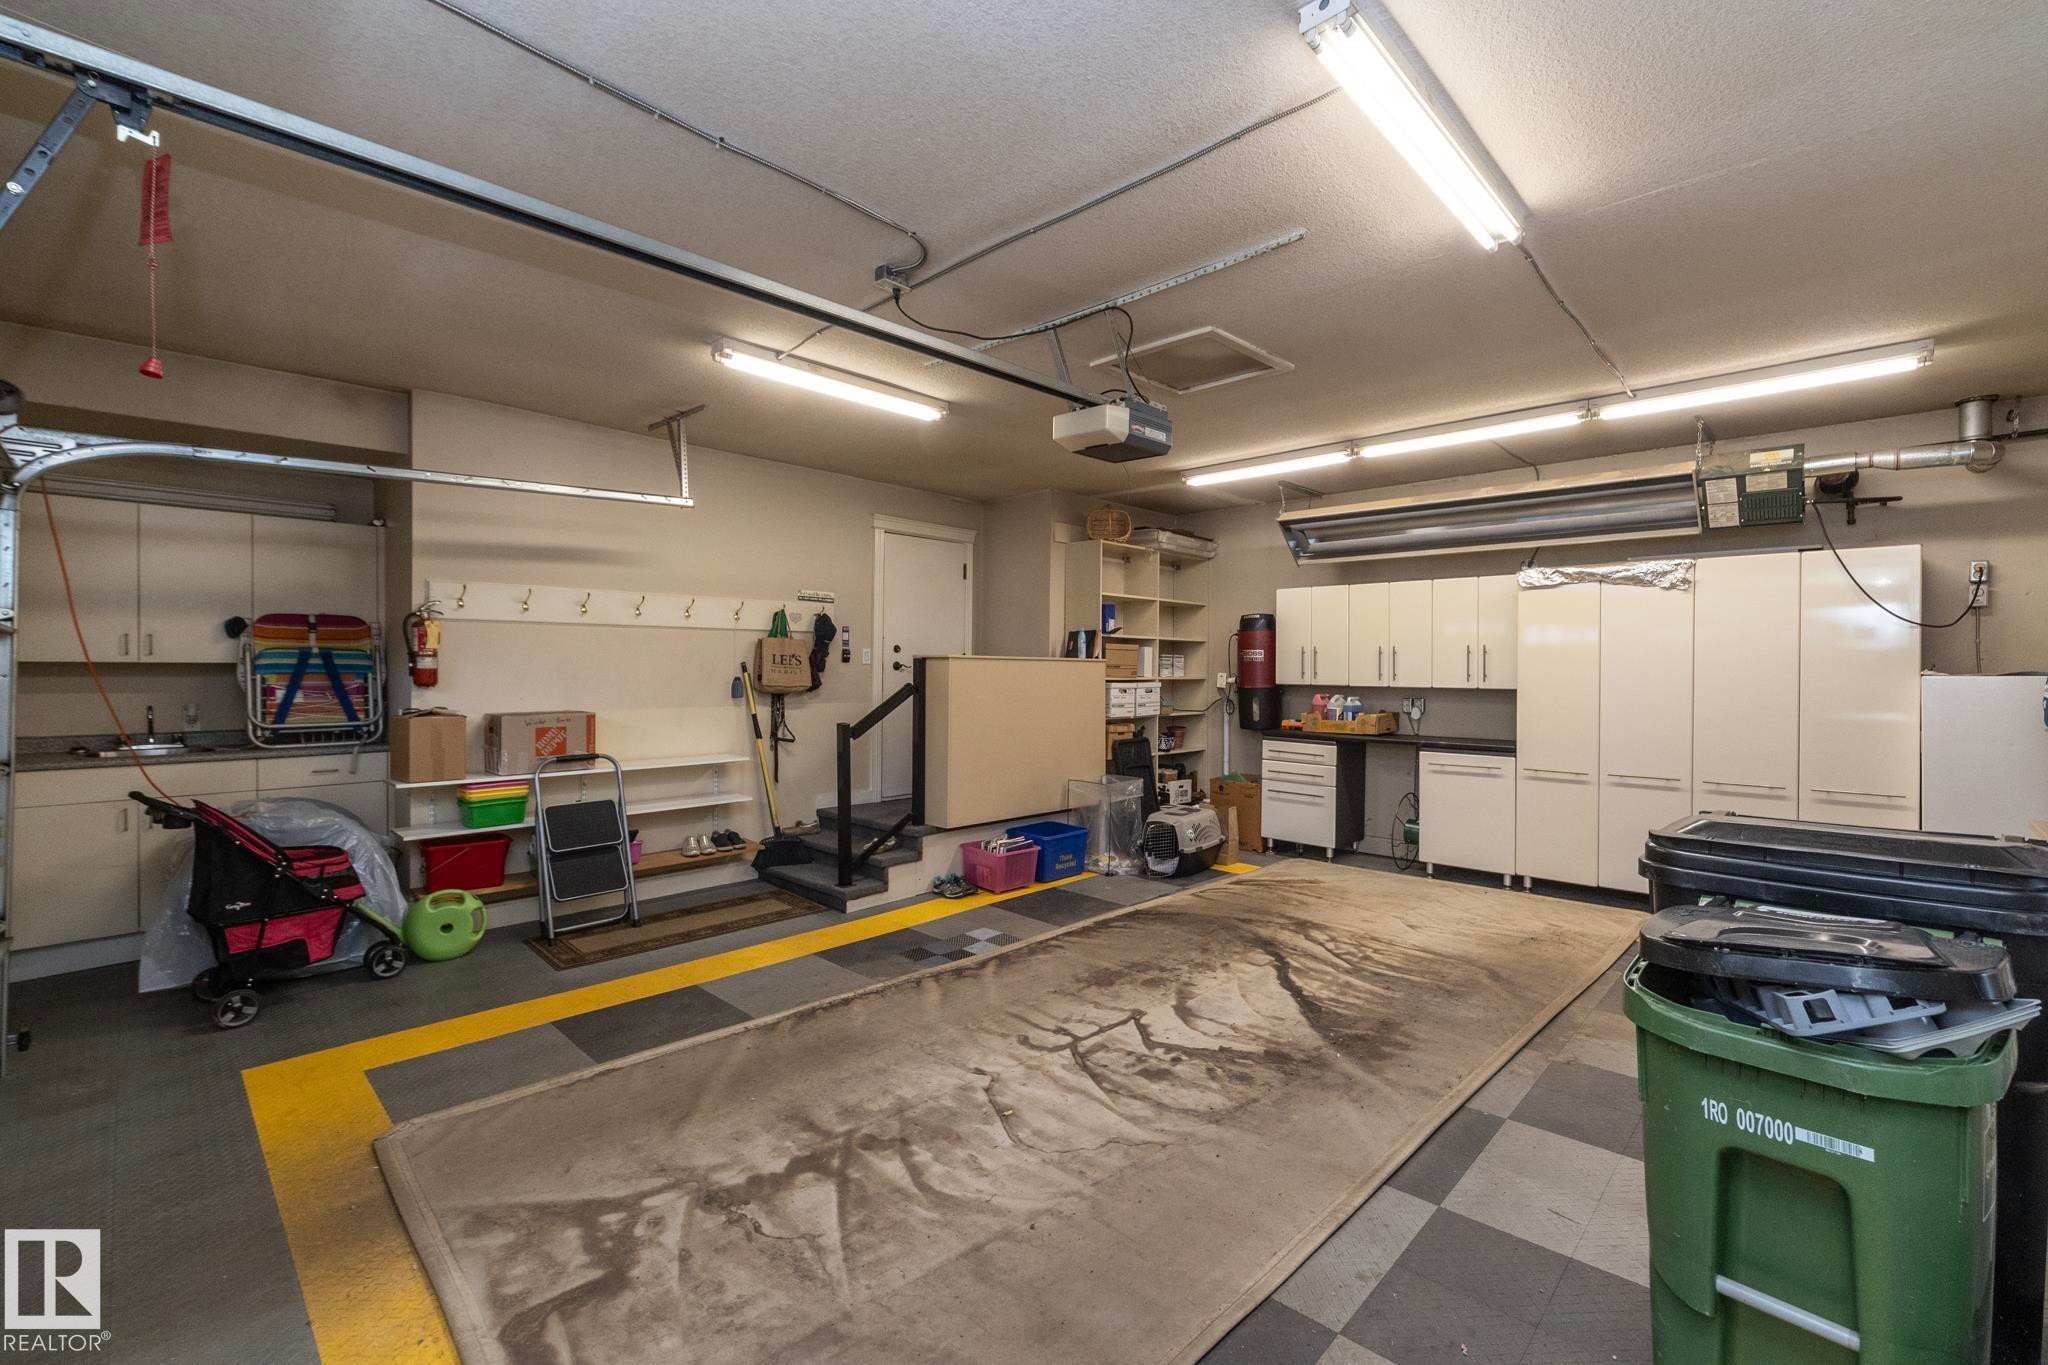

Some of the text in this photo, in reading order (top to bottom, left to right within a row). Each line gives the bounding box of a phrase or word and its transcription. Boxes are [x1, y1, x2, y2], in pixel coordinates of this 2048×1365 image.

[772, 654, 802, 666] LEE'S
[536, 727, 561, 750] HOME
[541, 730, 567, 755] DEPOT
[1736, 1107, 1794, 1145] 007000
